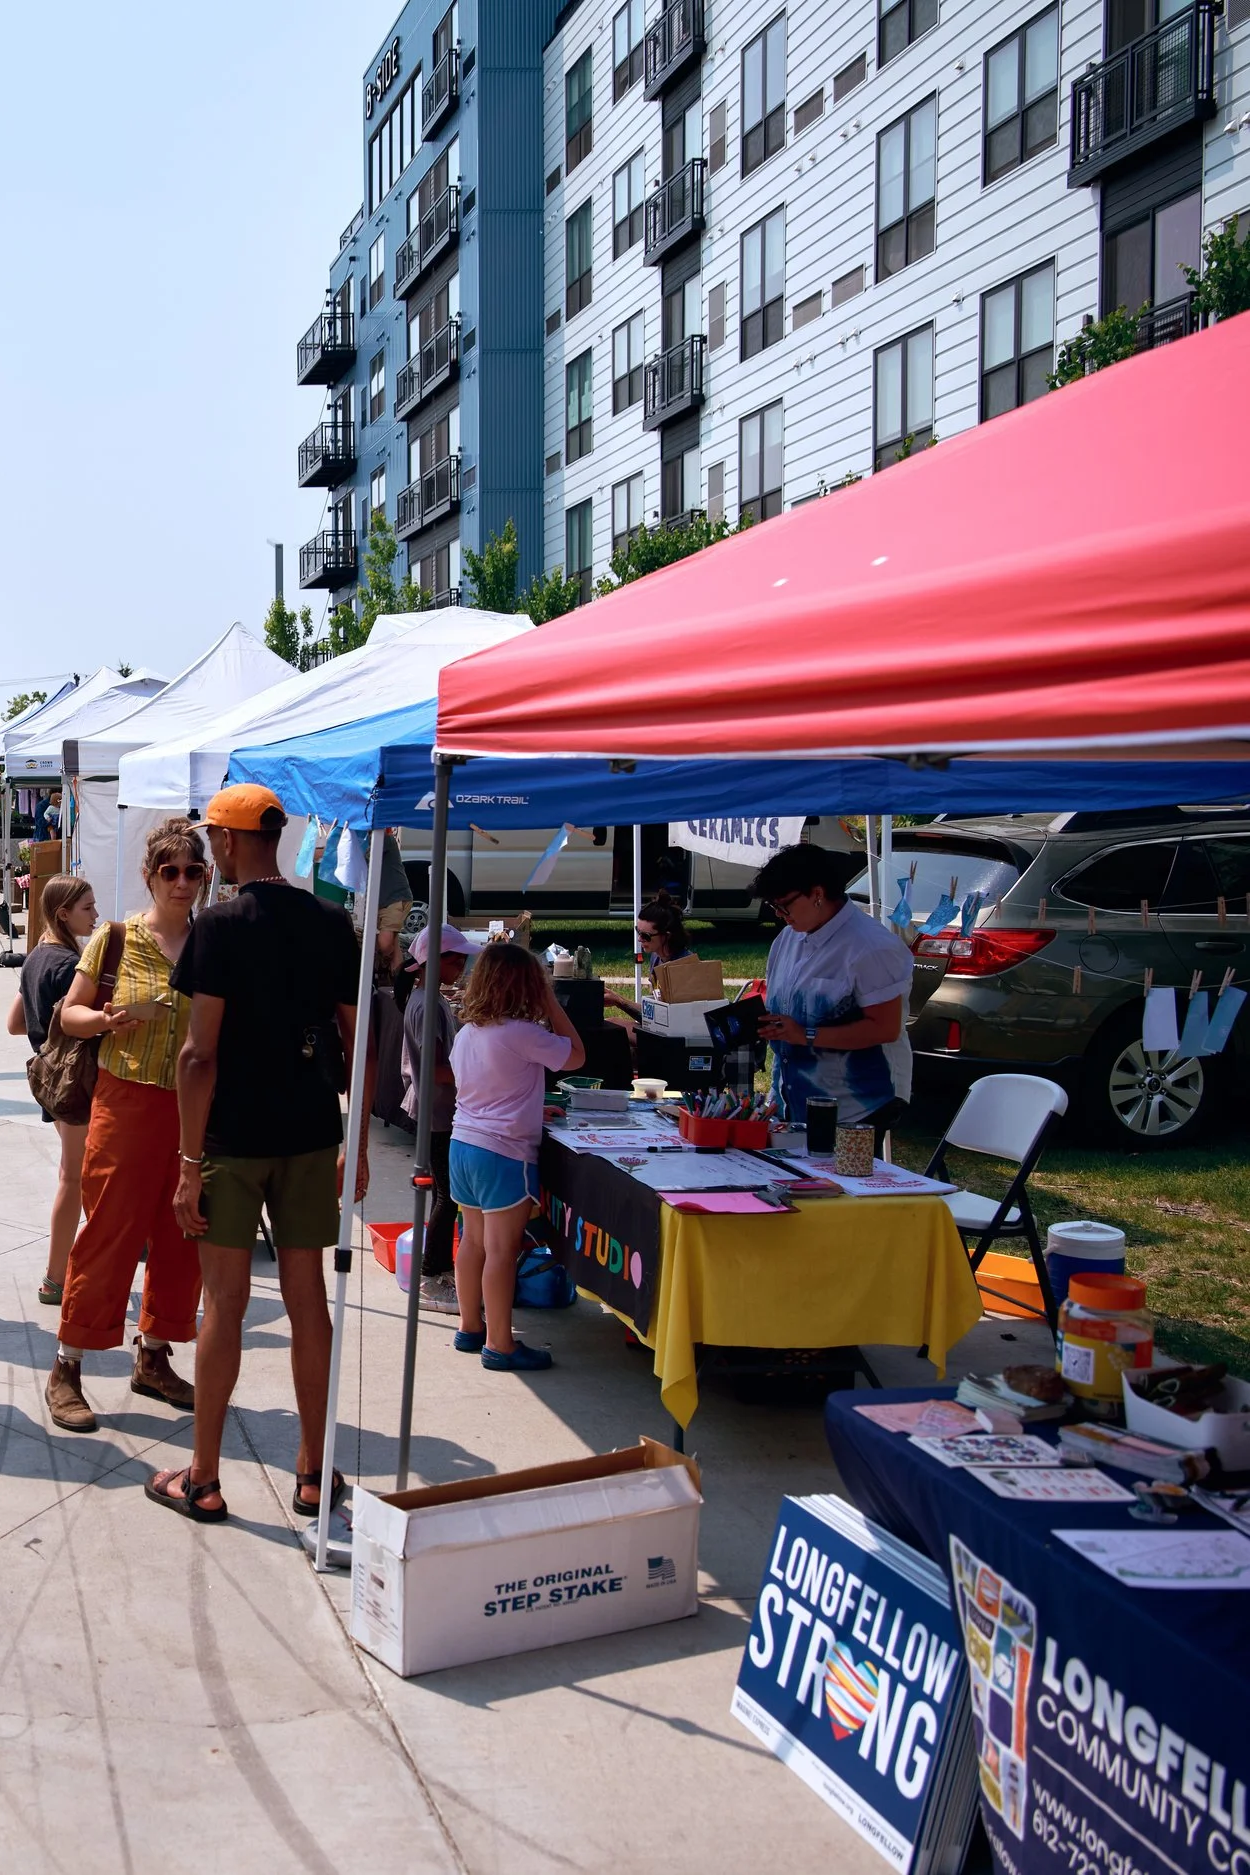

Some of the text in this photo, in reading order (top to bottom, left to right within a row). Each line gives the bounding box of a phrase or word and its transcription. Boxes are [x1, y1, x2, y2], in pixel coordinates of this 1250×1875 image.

[366, 36, 399, 120] B-SIDE
[575, 1216, 642, 1289] STUDIO
[483, 1577, 623, 1617] STEP STAKE
[494, 1563, 614, 1596] THE ORIGINAL
[769, 1525, 959, 1704] LONGFELLOW
[749, 1583, 938, 1799] STRNG
[1036, 1695, 1201, 1846] COMMUNITY
[858, 1813, 904, 1861] LONGFELLOW
